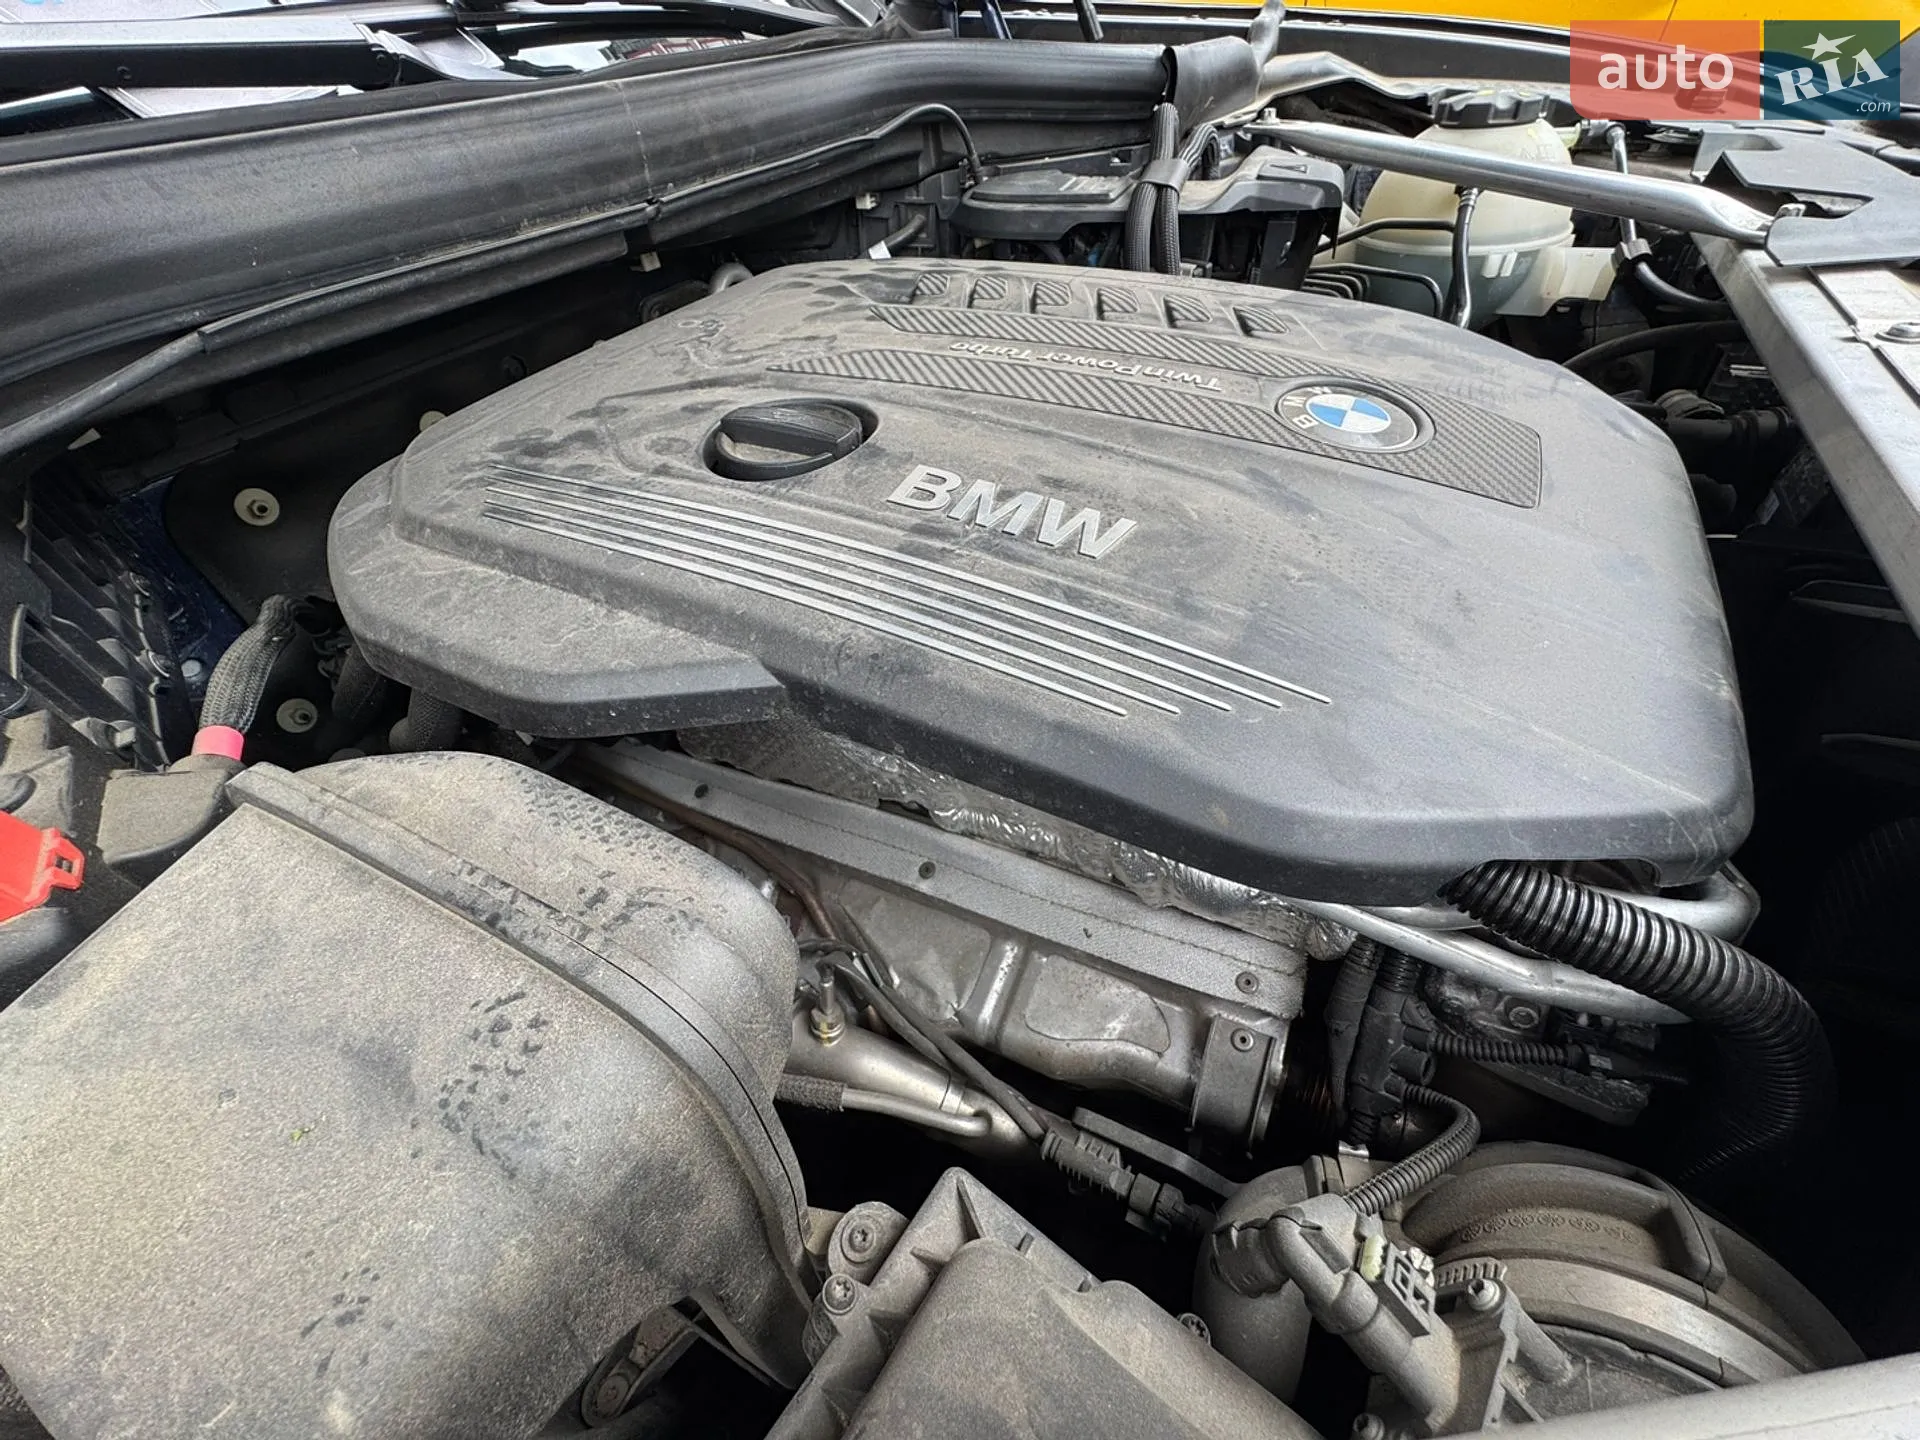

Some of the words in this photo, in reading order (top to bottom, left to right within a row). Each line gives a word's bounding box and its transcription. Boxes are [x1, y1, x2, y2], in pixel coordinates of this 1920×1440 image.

[950, 342, 1032, 361] Turbo
[1036, 352, 1223, 392] TwinPower
[886, 464, 1138, 560] BMW
